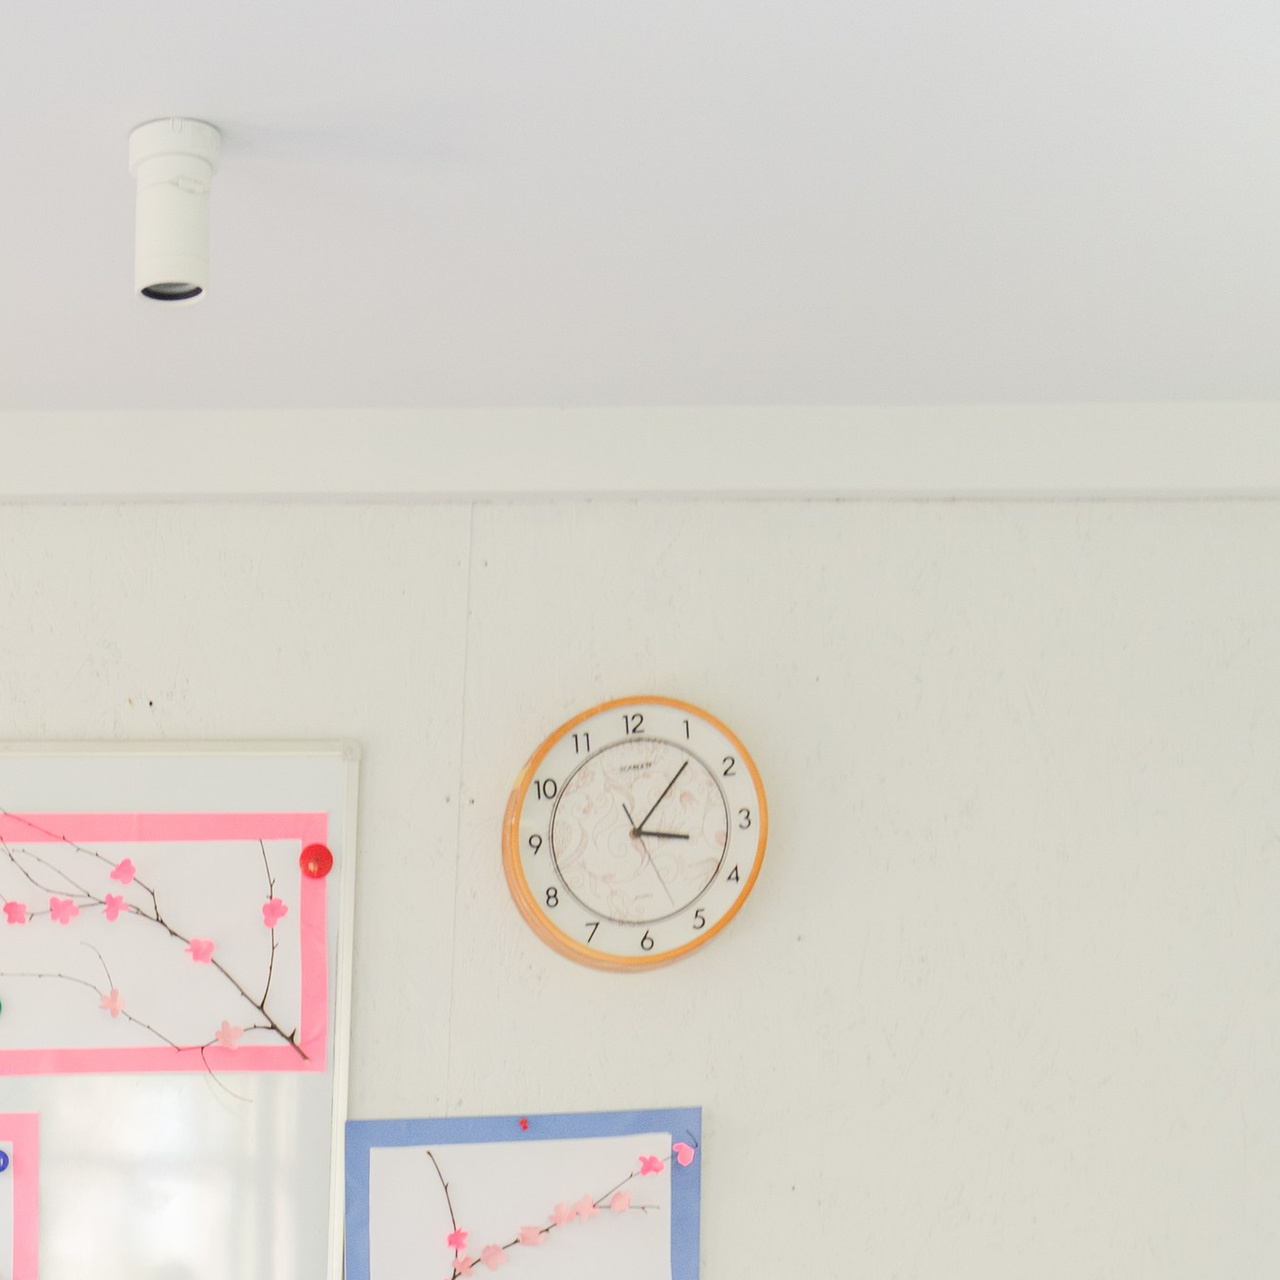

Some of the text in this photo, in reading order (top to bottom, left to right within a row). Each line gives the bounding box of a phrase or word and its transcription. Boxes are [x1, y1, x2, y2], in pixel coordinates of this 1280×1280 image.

[623, 713, 644, 735] 12
[683, 719, 690, 740] 1
[572, 732, 590, 754] 11
[722, 756, 735, 777] 2
[533, 778, 558, 801] 10
[738, 808, 752, 829] 3
[528, 834, 543, 855] 9
[726, 864, 740, 883] 4
[545, 886, 559, 908] 8
[693, 908, 706, 930] 5
[585, 921, 600, 944] 7
[640, 930, 655, 951] 6
